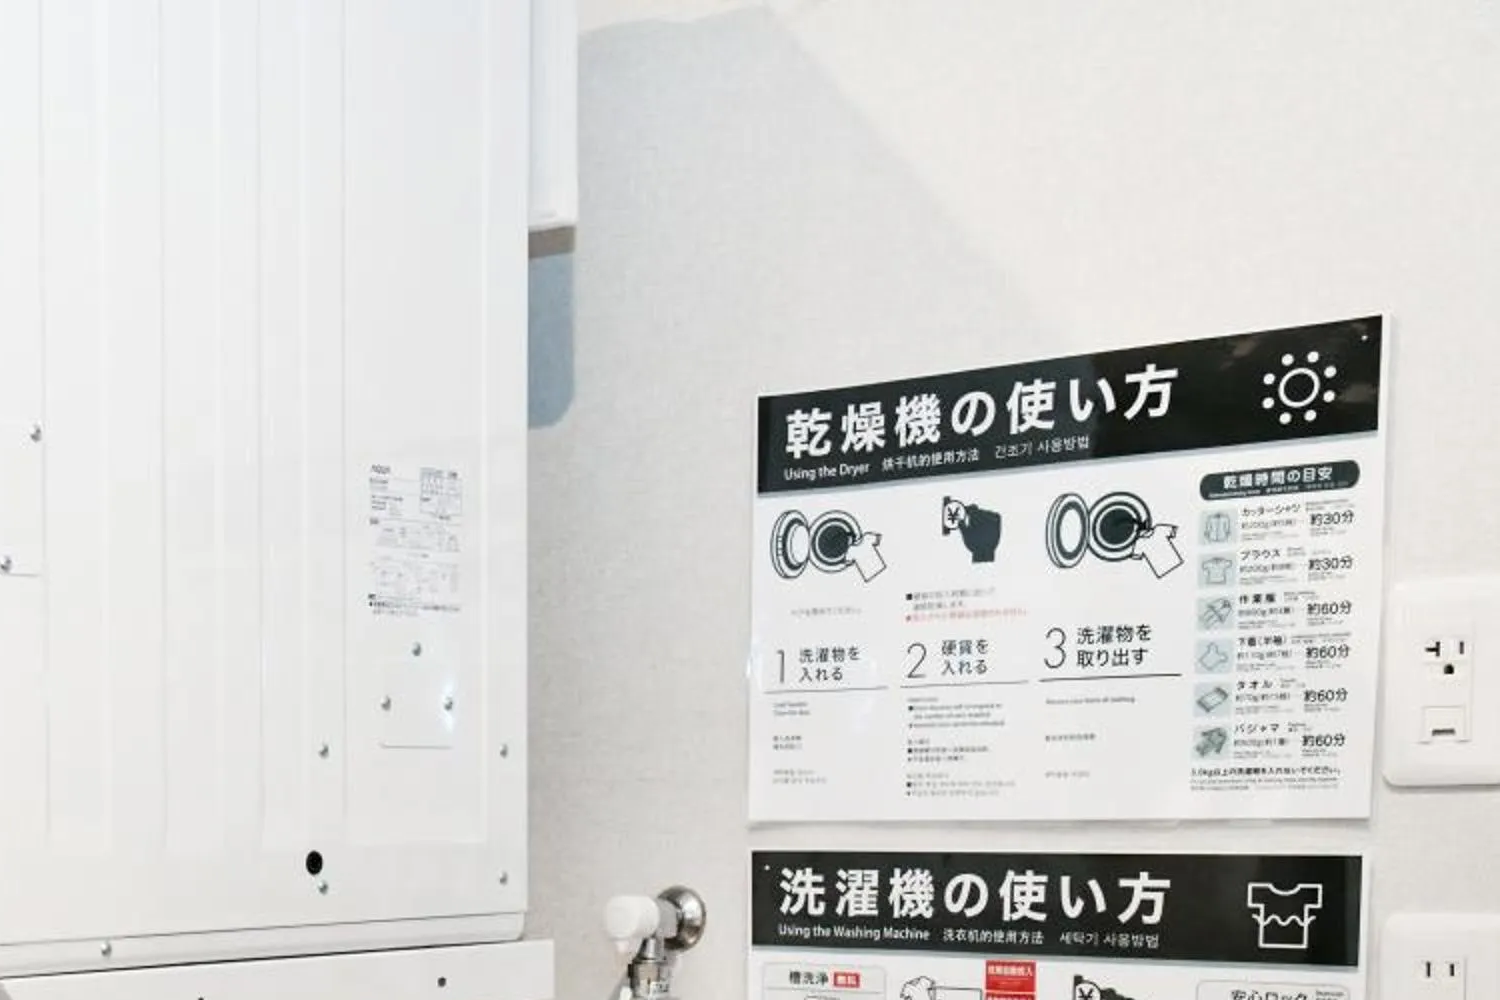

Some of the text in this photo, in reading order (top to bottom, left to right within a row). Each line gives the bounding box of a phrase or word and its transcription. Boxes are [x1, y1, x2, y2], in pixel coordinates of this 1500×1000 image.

[785, 363, 1180, 460] 乾燥機の使い方
[784, 462, 870, 481] Using the Dryer
[1310, 510, 1354, 526] 約30分
[1307, 555, 1354, 571] 約30分
[1306, 600, 1352, 616] 約60分
[1044, 624, 1152, 669] 3 洗濯物を
[1305, 644, 1351, 660] 約60分
[777, 645, 861, 684] 1 洗濯物を
[907, 638, 989, 679] 2 硬貨を
[941, 658, 988, 676] 入れる
[1077, 647, 1149, 669] 取り出す
[798, 666, 844, 683] 入れる
[1303, 688, 1349, 703] 約60分
[1301, 733, 1346, 748] 約60分
[779, 867, 1171, 925] 洗濯機の使い方
[778, 923, 930, 942] Using the Washing Machine
[789, 970, 829, 986] 槽洗浄
